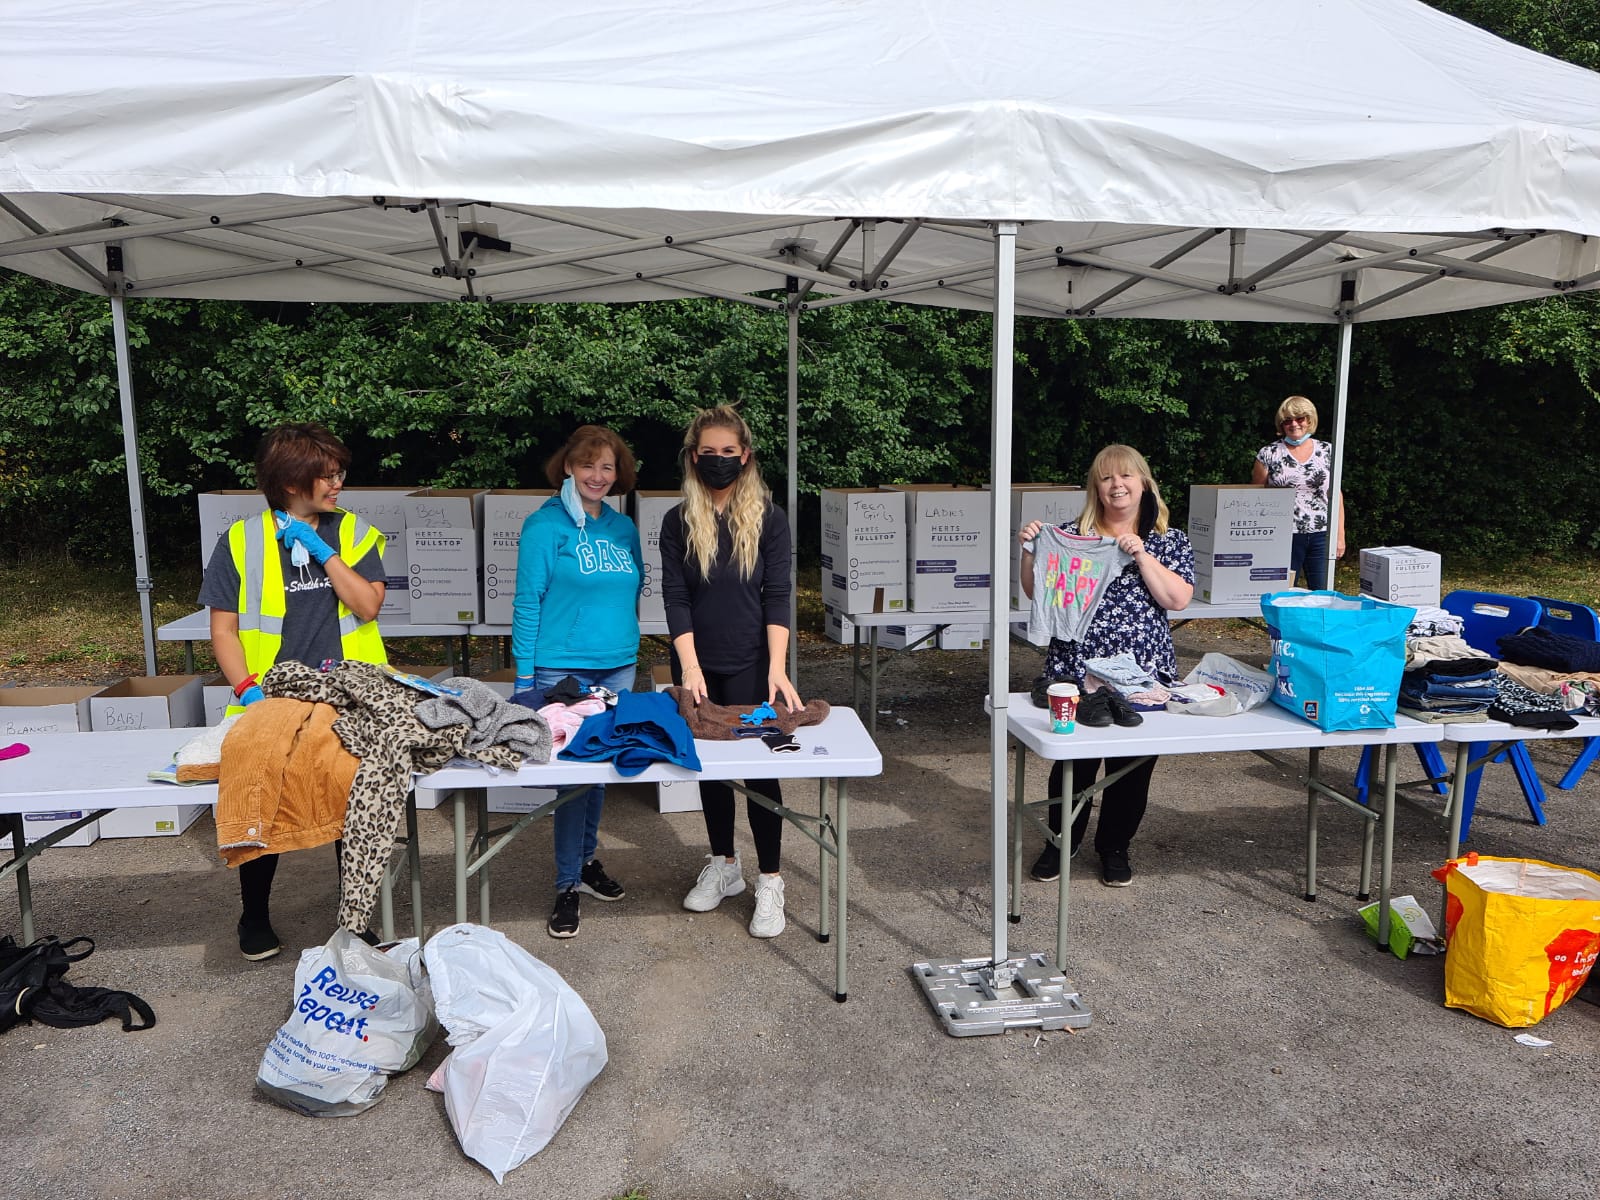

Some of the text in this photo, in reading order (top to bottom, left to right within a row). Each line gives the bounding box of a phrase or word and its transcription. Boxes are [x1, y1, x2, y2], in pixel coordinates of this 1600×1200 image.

[1230, 529, 1274, 537] FULLSTOP
[576, 540, 633, 575] GAP
[1061, 702, 1069, 727] COSTA
[311, 966, 380, 1010] Reuse.
[289, 1037, 304, 1049] made
[318, 1051, 337, 1062] 100%
[338, 1058, 368, 1069] recycled
[292, 1050, 306, 1063] long
[312, 1061, 327, 1070] you
